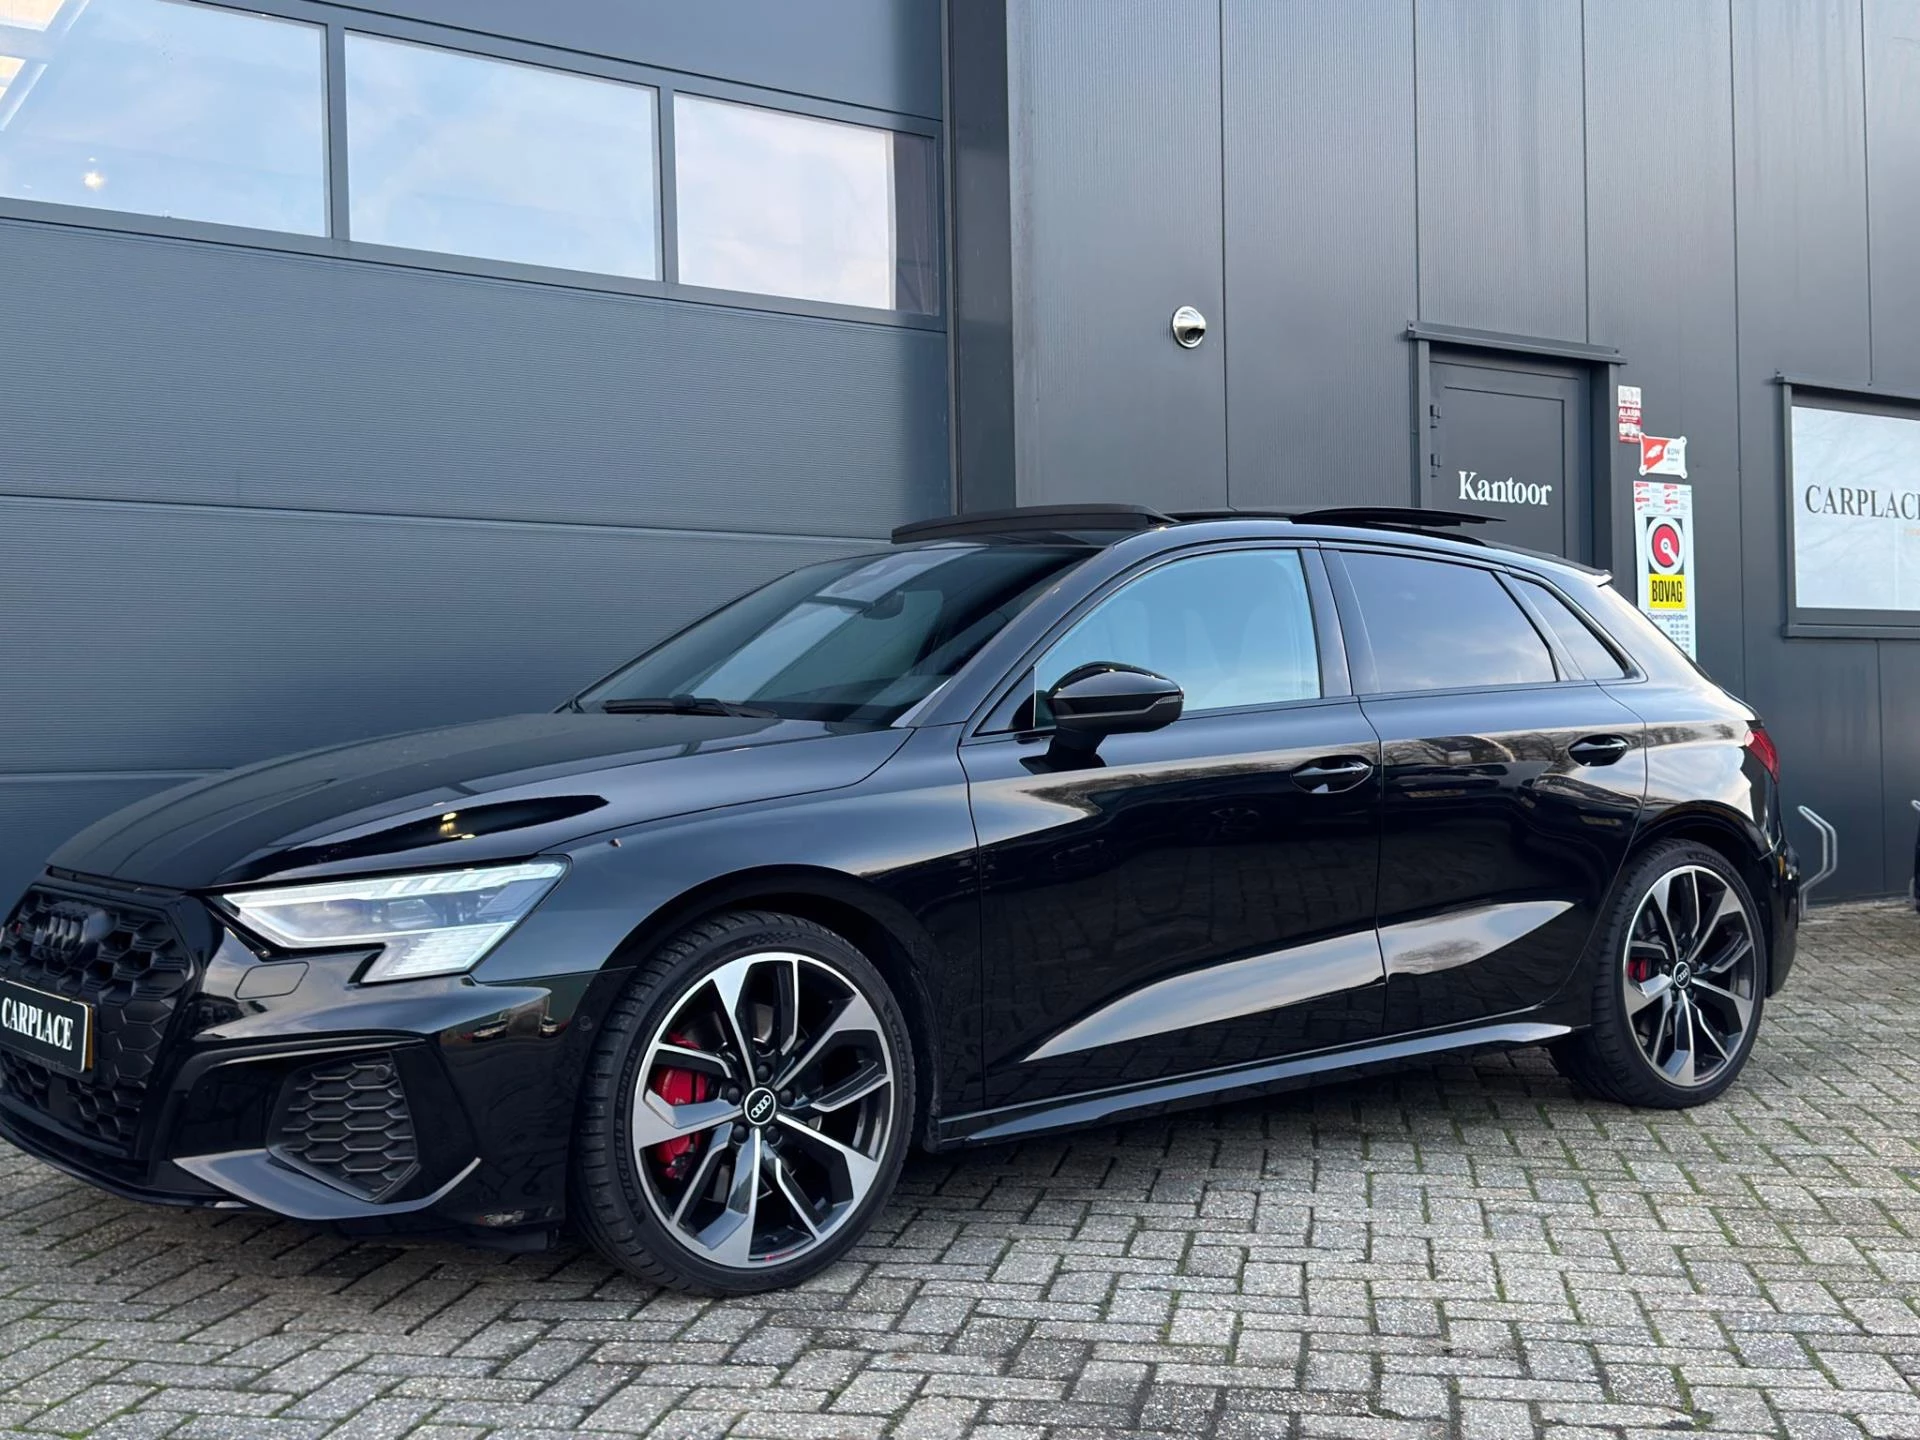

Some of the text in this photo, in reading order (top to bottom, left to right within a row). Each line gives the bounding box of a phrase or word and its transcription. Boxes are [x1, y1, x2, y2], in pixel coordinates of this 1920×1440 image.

[1458, 470, 1553, 506] Kantoor
[1651, 580, 1683, 603] BOVAG
[1, 997, 74, 1051] CARPLACE
